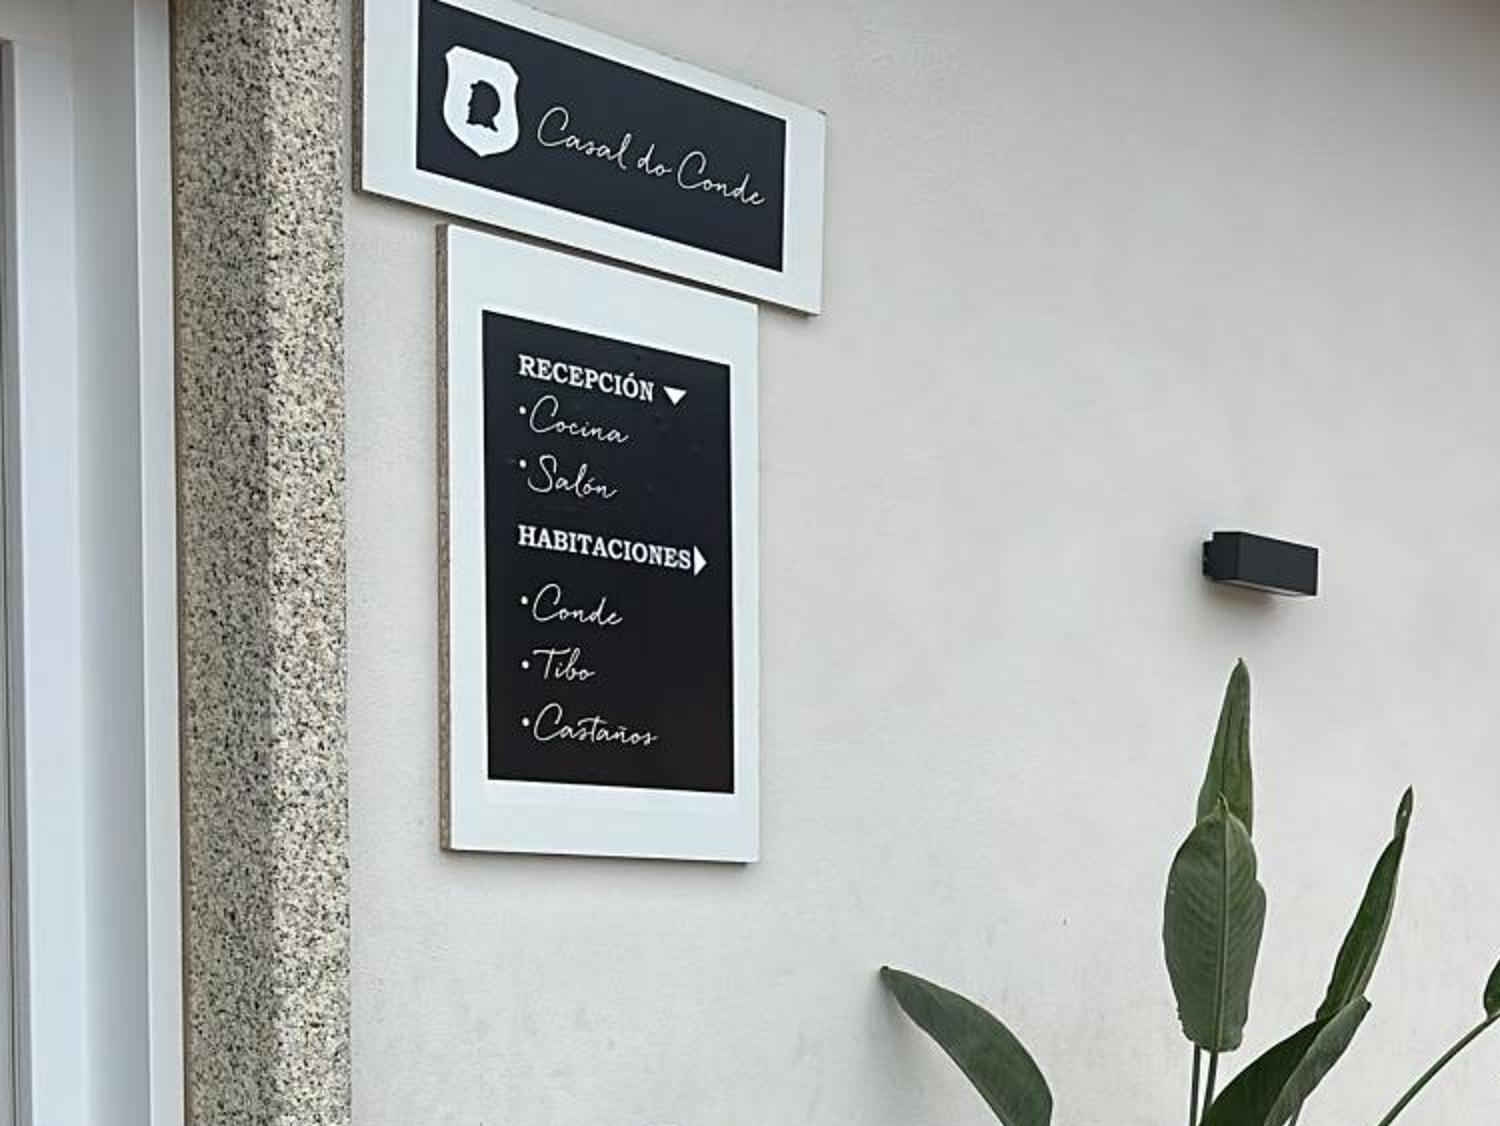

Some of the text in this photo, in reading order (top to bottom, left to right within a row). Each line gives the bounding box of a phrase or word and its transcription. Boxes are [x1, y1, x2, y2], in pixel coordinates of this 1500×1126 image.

[537, 106, 766, 206] Casal do Conde
[517, 352, 655, 403] RECEPCIÓN
[529, 394, 630, 443] Cocina
[527, 454, 618, 500] Salón
[517, 524, 691, 570] HABITACIONES
[531, 583, 623, 626] Conde
[532, 647, 597, 682] Tibo
[532, 702, 658, 746] Castaños
